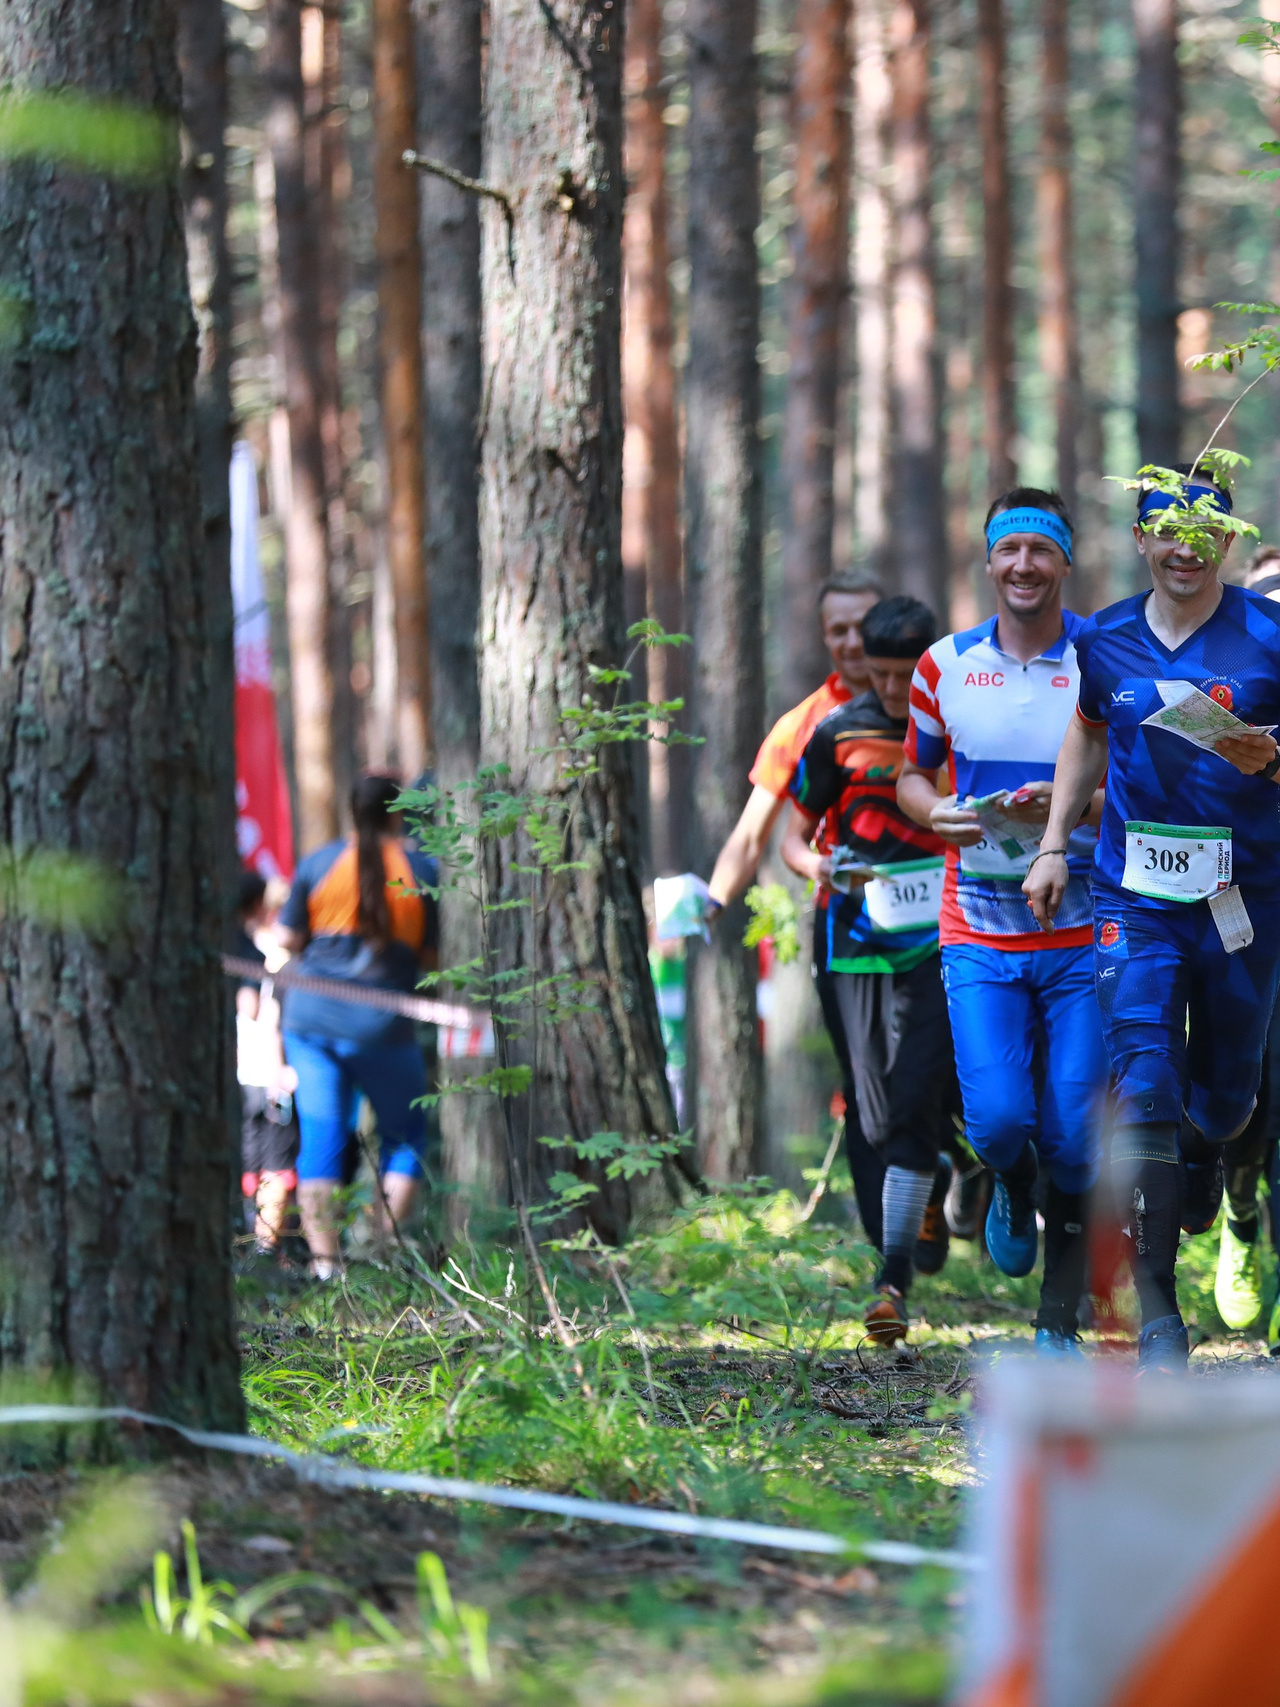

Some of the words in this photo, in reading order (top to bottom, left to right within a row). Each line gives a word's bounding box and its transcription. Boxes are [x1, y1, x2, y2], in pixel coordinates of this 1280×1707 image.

[964, 672, 1004, 687] ABC
[1144, 847, 1190, 874] 308
[890, 882, 930, 908] 302
